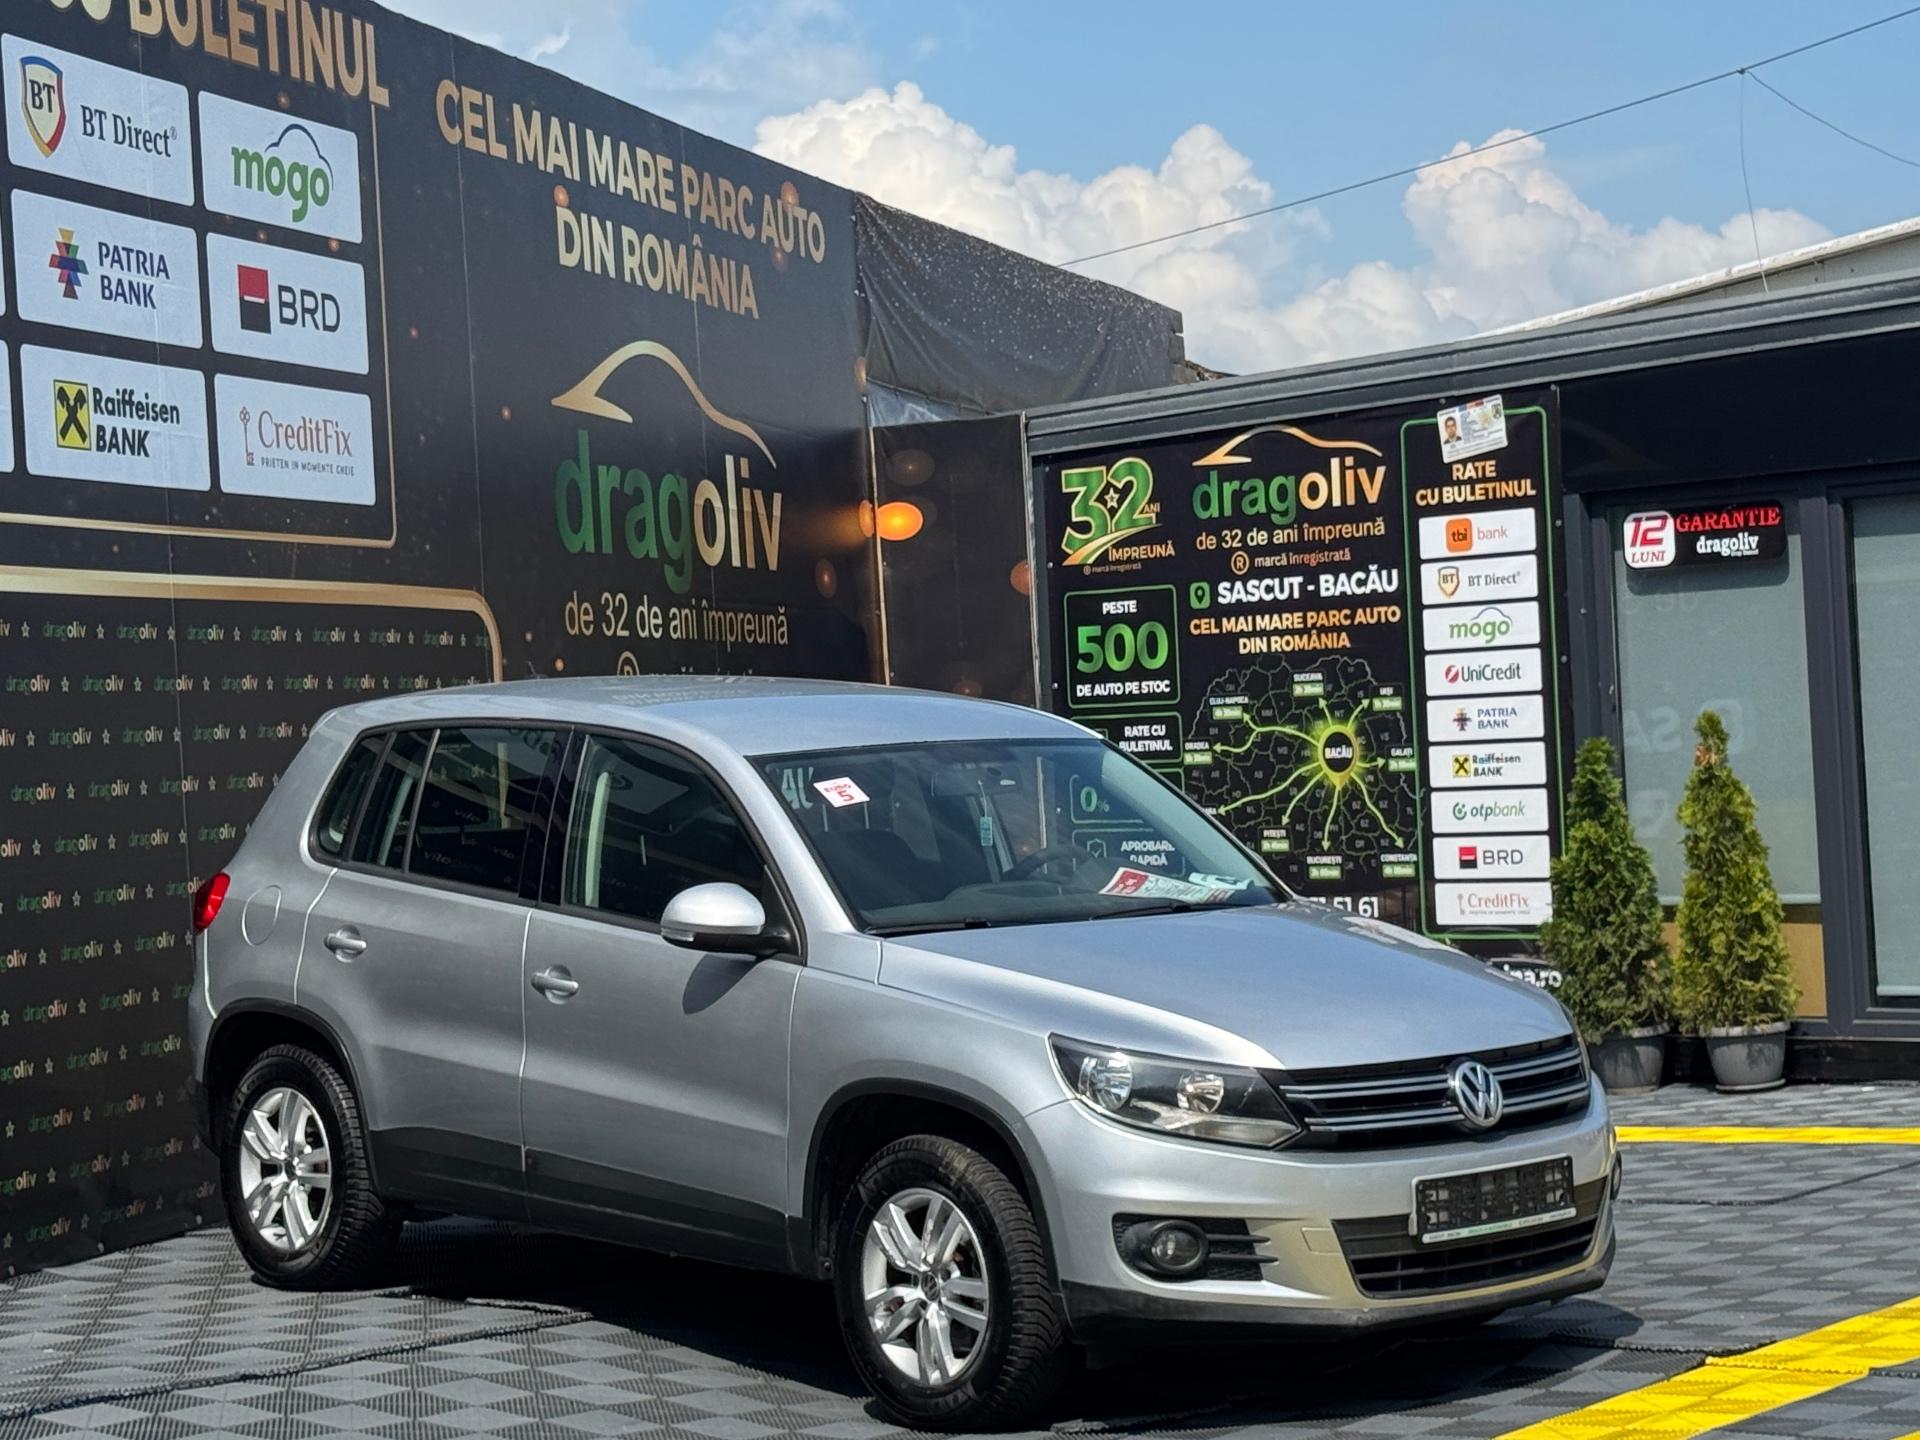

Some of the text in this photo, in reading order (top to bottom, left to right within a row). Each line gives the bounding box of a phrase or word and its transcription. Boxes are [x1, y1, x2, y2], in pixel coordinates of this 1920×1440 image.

[28, 80, 56, 113] BT
[80, 105, 109, 142] BT
[231, 146, 329, 223] mogo
[435, 79, 826, 264] CEL MAI MARE PARC AUTO
[98, 241, 171, 281] PATRIA
[555, 206, 760, 320] DIN ROMÂNIA
[100, 274, 157, 311] BANK
[278, 284, 341, 333] BRD
[92, 387, 180, 426] Raiffeisen
[95, 424, 150, 458] BANK
[258, 411, 353, 457] CreditFix
[1452, 460, 1497, 481] RATE
[1192, 456, 1387, 525] dragoliv
[1415, 478, 1537, 507] CU BULETINUL
[555, 429, 782, 595] dragoliv
[1061, 457, 1156, 556] 32
[1196, 516, 1386, 552] de 32 de ani împreună
[1451, 525, 1509, 544] tbi bank
[1629, 514, 1669, 549] 12
[1696, 532, 1760, 557] dragoliv
[1109, 541, 1176, 562] ÎMPREUNĂ
[1254, 553, 1288, 568] marcă
[1631, 551, 1666, 564] LUNI
[1217, 576, 1303, 605] SASCUT
[1319, 564, 1400, 599] BACĂU
[1467, 575, 1483, 588] BT
[565, 590, 789, 653] de 32 de ani împreună
[1102, 600, 1138, 615] PESTE
[1189, 604, 1401, 636] CEL MAI MARE PARC AUTO
[43, 621, 86, 643] dragoliv
[116, 623, 158, 644] dragoliv
[186, 624, 224, 644] dragoliv
[252, 625, 287, 645] dragoliv
[311, 626, 346, 646] dragoliv
[369, 628, 401, 646] dragoliv
[423, 630, 454, 647] dragoliv
[1239, 630, 1352, 655] DIN ROMÂNIA
[1449, 619, 1511, 644] mogo
[1076, 621, 1169, 673] 500
[6, 674, 51, 695] dragoliv
[81, 674, 124, 695] dragoliv
[153, 674, 193, 695] dragoliv
[221, 674, 258, 694] dragoliv
[284, 674, 319, 693] dragoliv
[342, 674, 376, 690] dragoliv
[398, 674, 429, 689] dragoliv
[1461, 661, 1522, 682] UniCredit
[1076, 680, 1171, 697] DE AUTO PE STOC
[1477, 707, 1518, 719] PATRIA
[1477, 718, 1510, 731] BANK
[49, 728, 92, 749] dragoliv
[122, 726, 163, 746] dragoliv
[192, 724, 231, 744] dragoliv
[258, 722, 293, 741] dragoliv
[1124, 725, 1166, 738] RATE CU
[1472, 753, 1522, 765] Raiffeisen
[1473, 765, 1503, 777] BANK
[11, 772, 264, 804] dragoliv dragoliv dragoliv dragoliv
[1470, 800, 1526, 821] otpbank
[54, 834, 98, 855] dragoliv
[128, 828, 169, 849] dragoliv
[199, 823, 236, 842] dragoliv
[1482, 848, 1524, 866] BRD
[16, 891, 62, 913] dragoliv
[94, 884, 136, 904] dragoliv
[1358, 896, 1380, 919] 61
[1467, 892, 1530, 909] CreditFix
[59, 941, 104, 963] dragoliv
[134, 932, 175, 952] dragoliv
[23, 989, 142, 1022] dragoliv dragoliv
[66, 1048, 109, 1070] dragoliv
[140, 1034, 181, 1057] dragoliv
